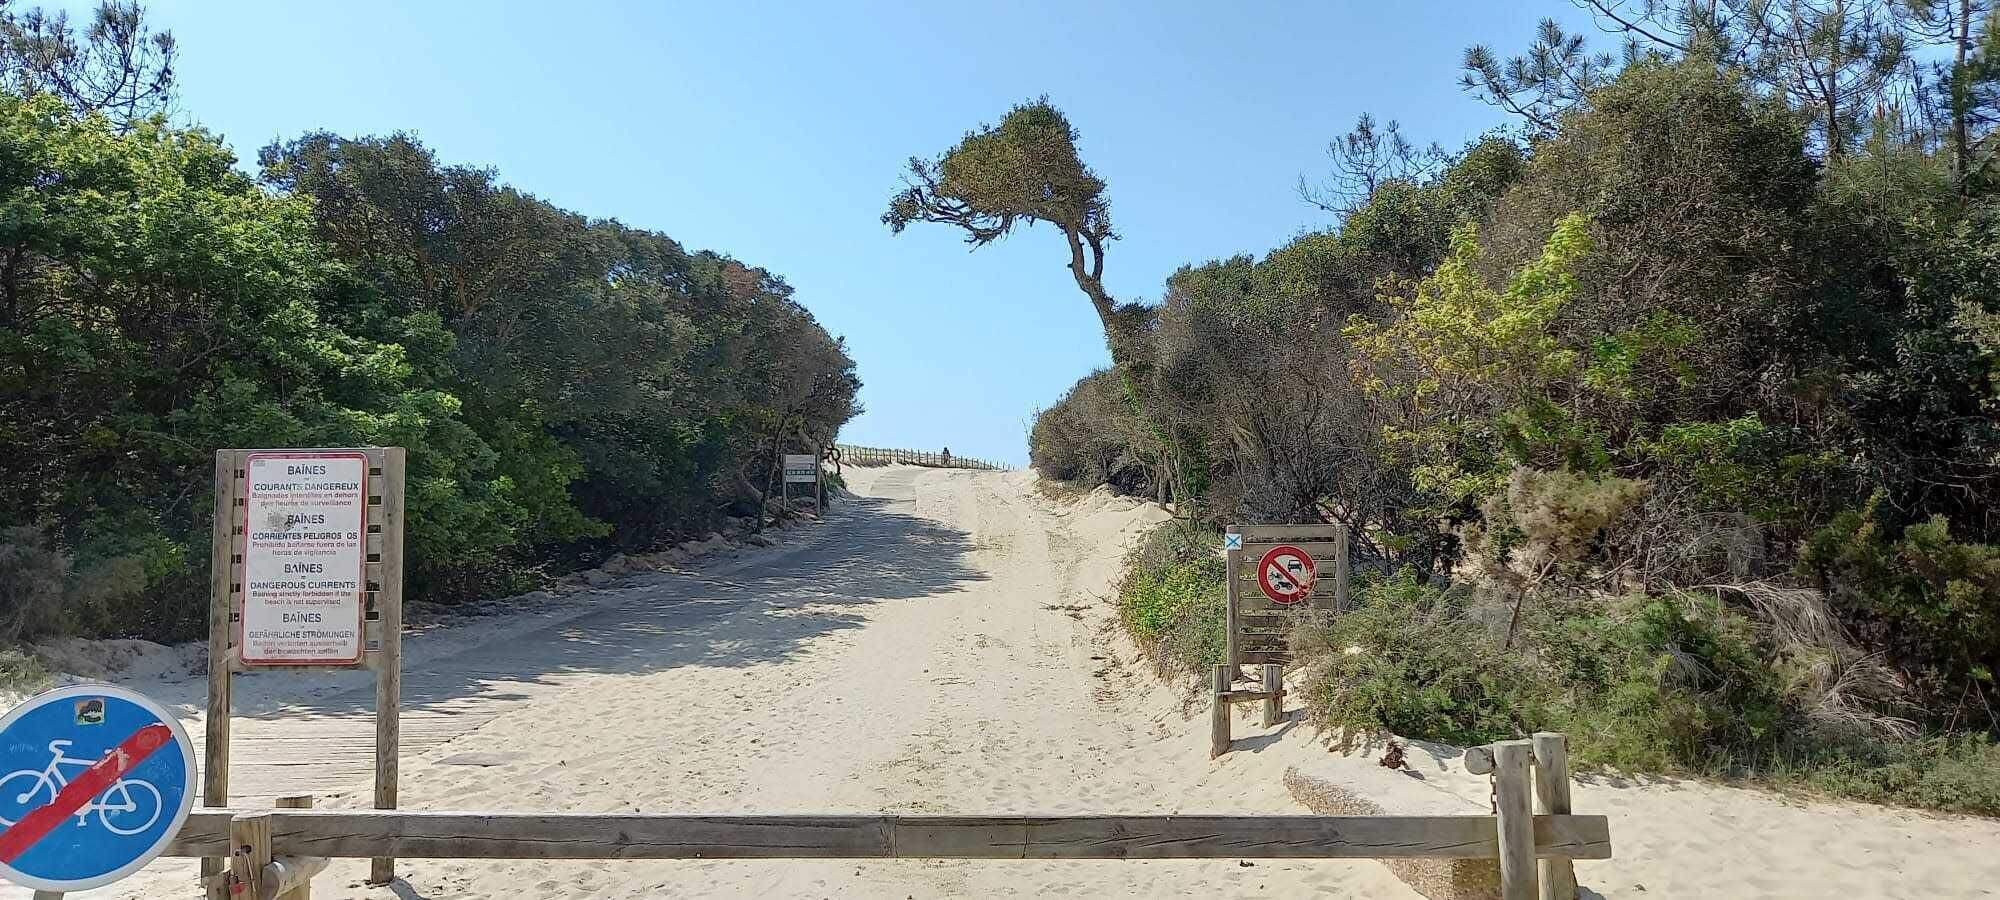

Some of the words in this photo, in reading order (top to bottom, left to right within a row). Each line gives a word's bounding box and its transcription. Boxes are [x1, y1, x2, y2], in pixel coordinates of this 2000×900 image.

[287, 464, 326, 475] BAÏNES
[254, 482, 303, 491] COURANTS
[304, 482, 359, 491] DANGEREUX
[252, 492, 288, 500] Baignades
[287, 513, 325, 524] BAÏNES
[252, 532, 302, 540] CORRIENTES
[304, 549, 336, 557] vigilancia
[284, 562, 323, 574] BAÏNES
[250, 581, 306, 590] DANGEROUS
[308, 581, 356, 589] CURRENTS
[279, 590, 300, 598] strictly
[305, 598, 341, 606] supervised
[282, 611, 322, 623] BAÏNES
[248, 629, 300, 639] GEFÄHRLICHE
[302, 629, 355, 638] STRÖMUNGEN
